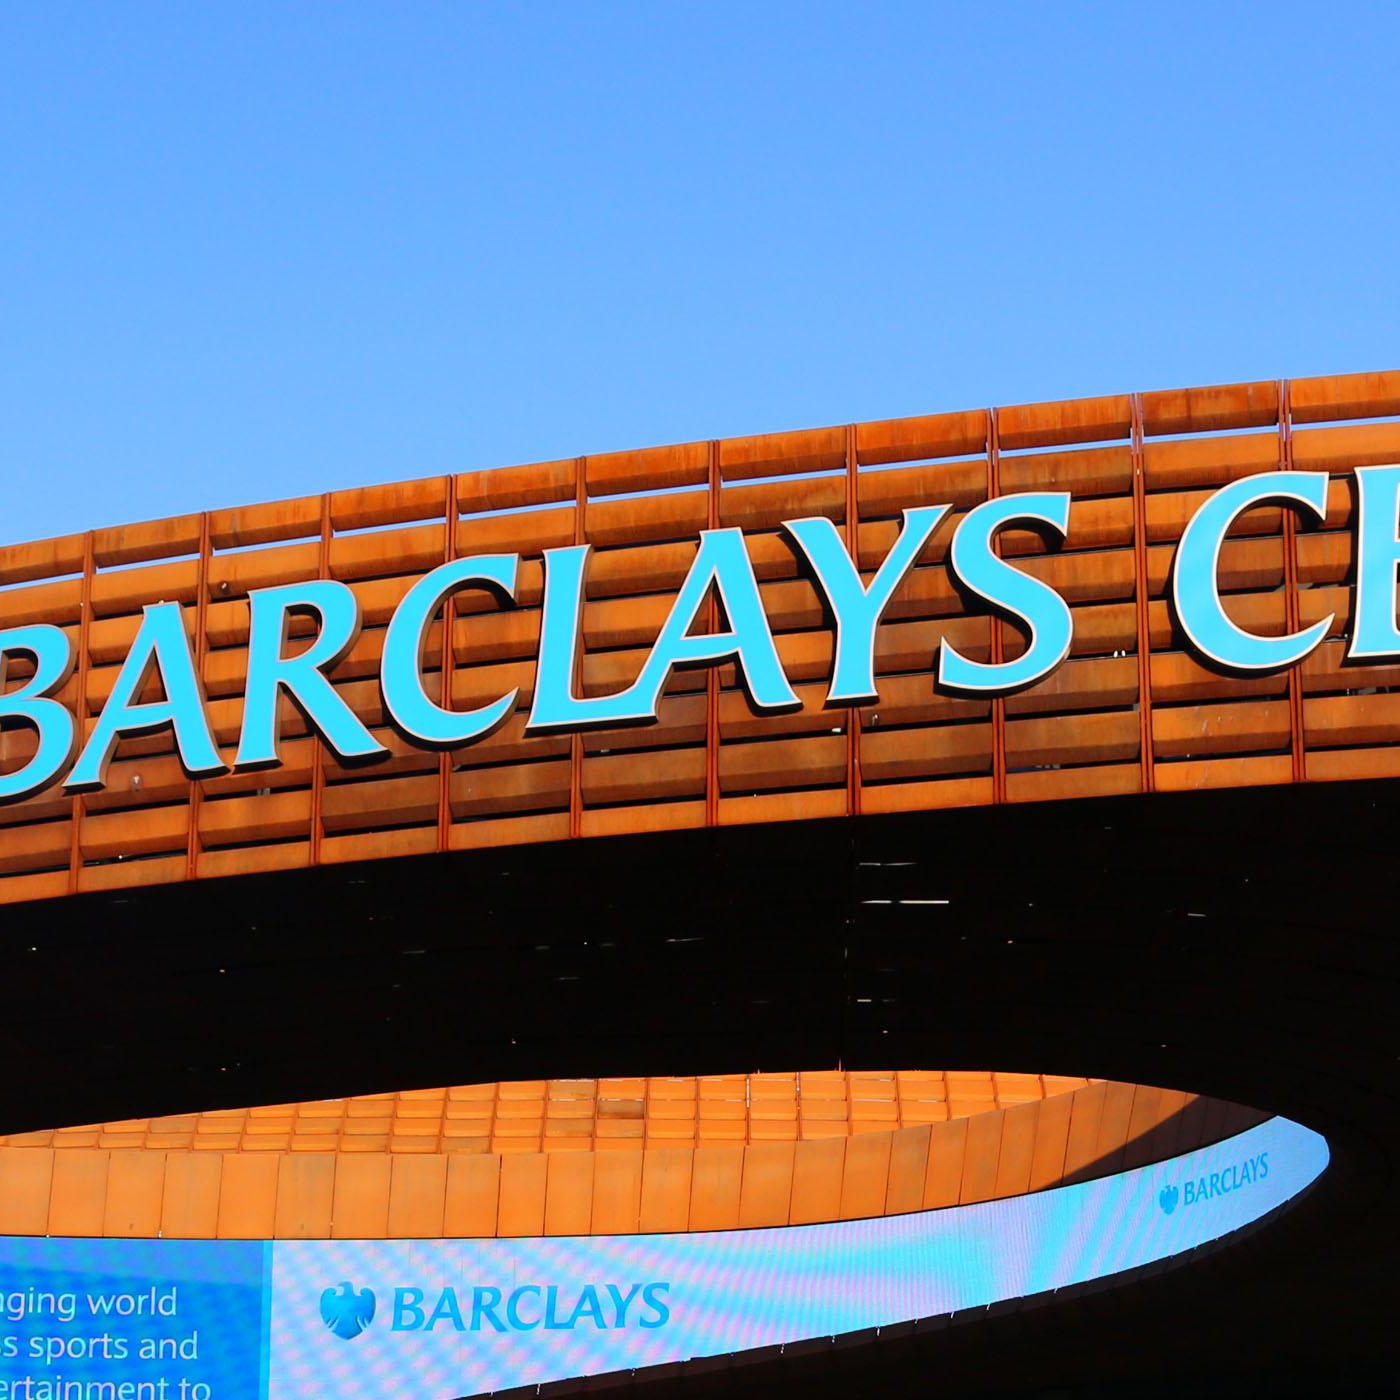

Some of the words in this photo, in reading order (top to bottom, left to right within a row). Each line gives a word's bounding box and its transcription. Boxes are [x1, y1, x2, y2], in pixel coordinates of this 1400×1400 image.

[1183, 1152, 1269, 1206] BARCLAYS
[87, 1286, 178, 1316] world
[391, 1282, 671, 1333] BARCLAYS
[29, 1333, 128, 1365] sports
[138, 1331, 198, 1360] and
